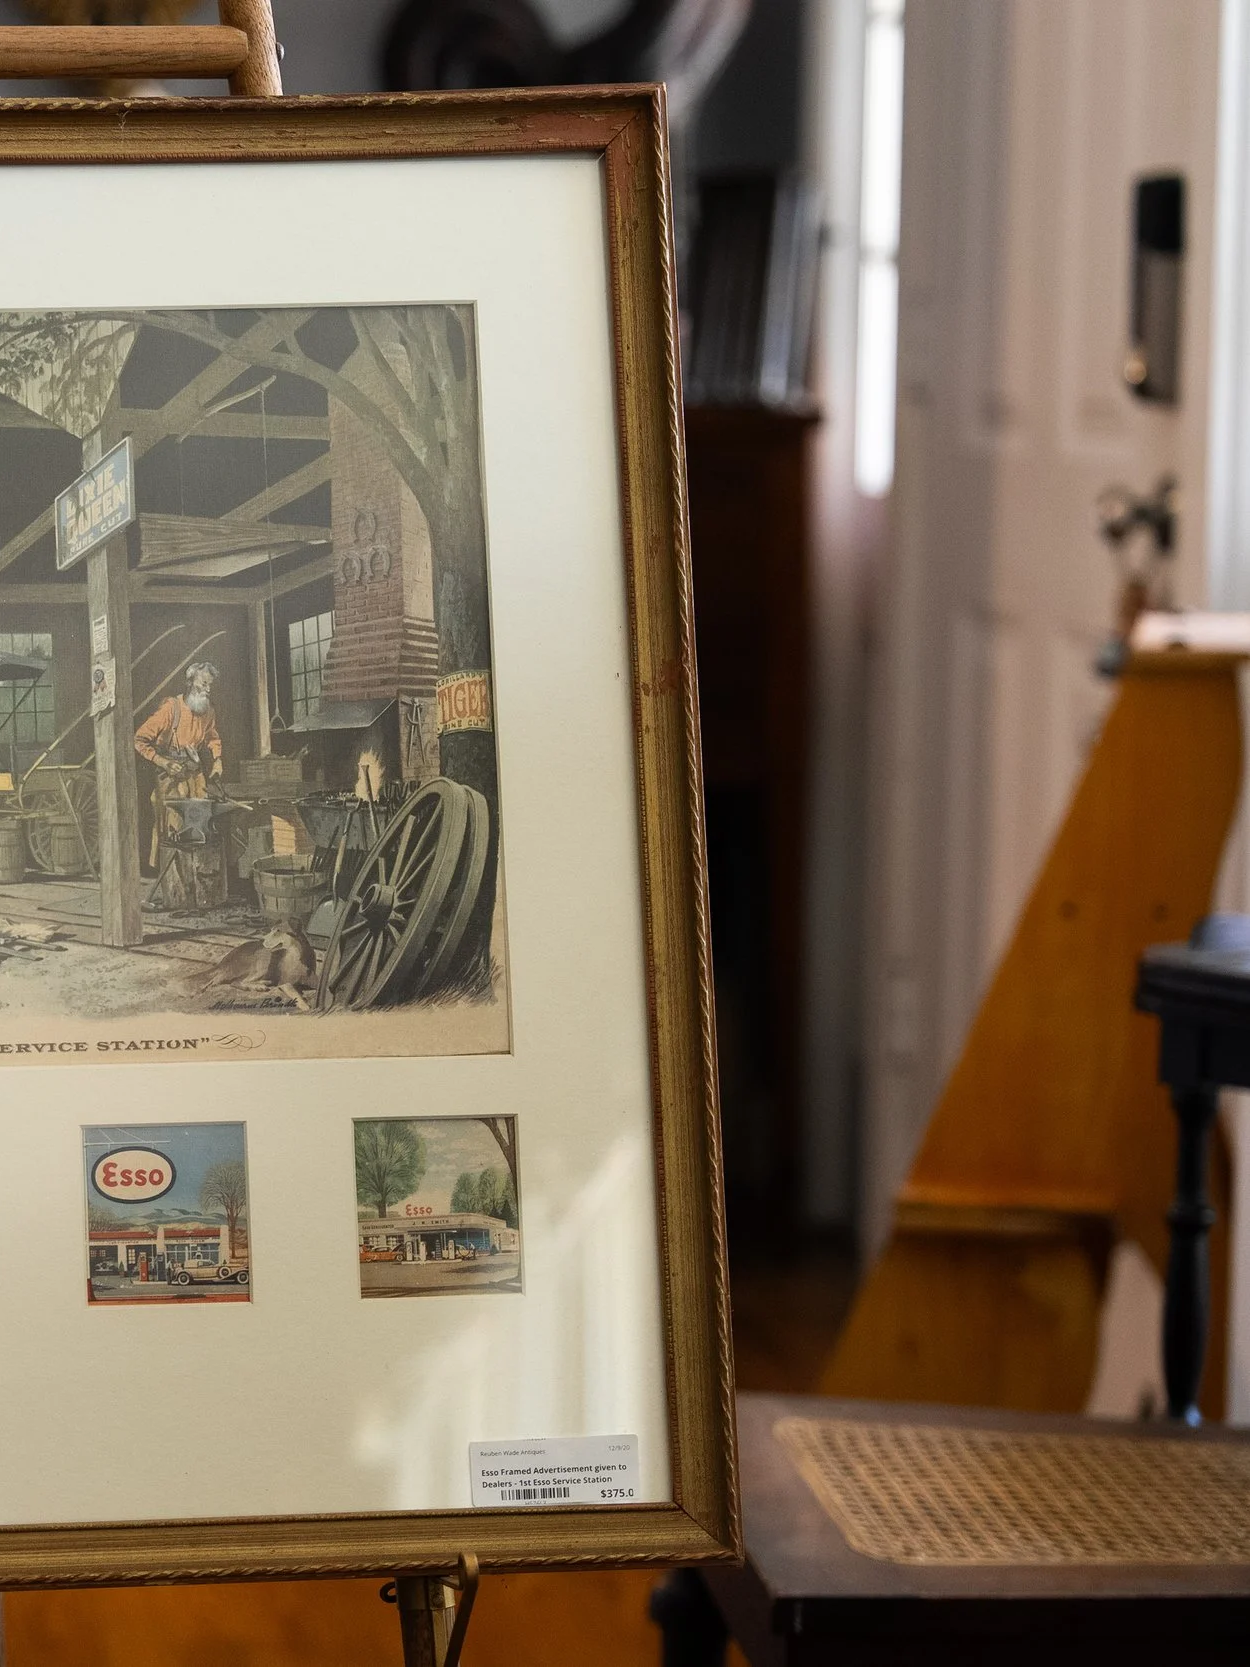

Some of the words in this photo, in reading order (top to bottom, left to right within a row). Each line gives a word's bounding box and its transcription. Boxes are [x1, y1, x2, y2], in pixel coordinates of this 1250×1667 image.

[103, 1162, 164, 1187] Esso
[521, 1448, 546, 1456] Antiques
[481, 1469, 499, 1477] Esso
[501, 1467, 532, 1476] Framed
[533, 1464, 593, 1475] Advertisement
[594, 1464, 617, 1473] given
[618, 1463, 627, 1471] to
[482, 1480, 512, 1489] Dealers
[519, 1479, 532, 1487] 1st
[533, 1478, 551, 1486] Esso
[552, 1477, 582, 1485] Service
[583, 1475, 613, 1484] Station
[600, 1488, 634, 1498] $375.0
